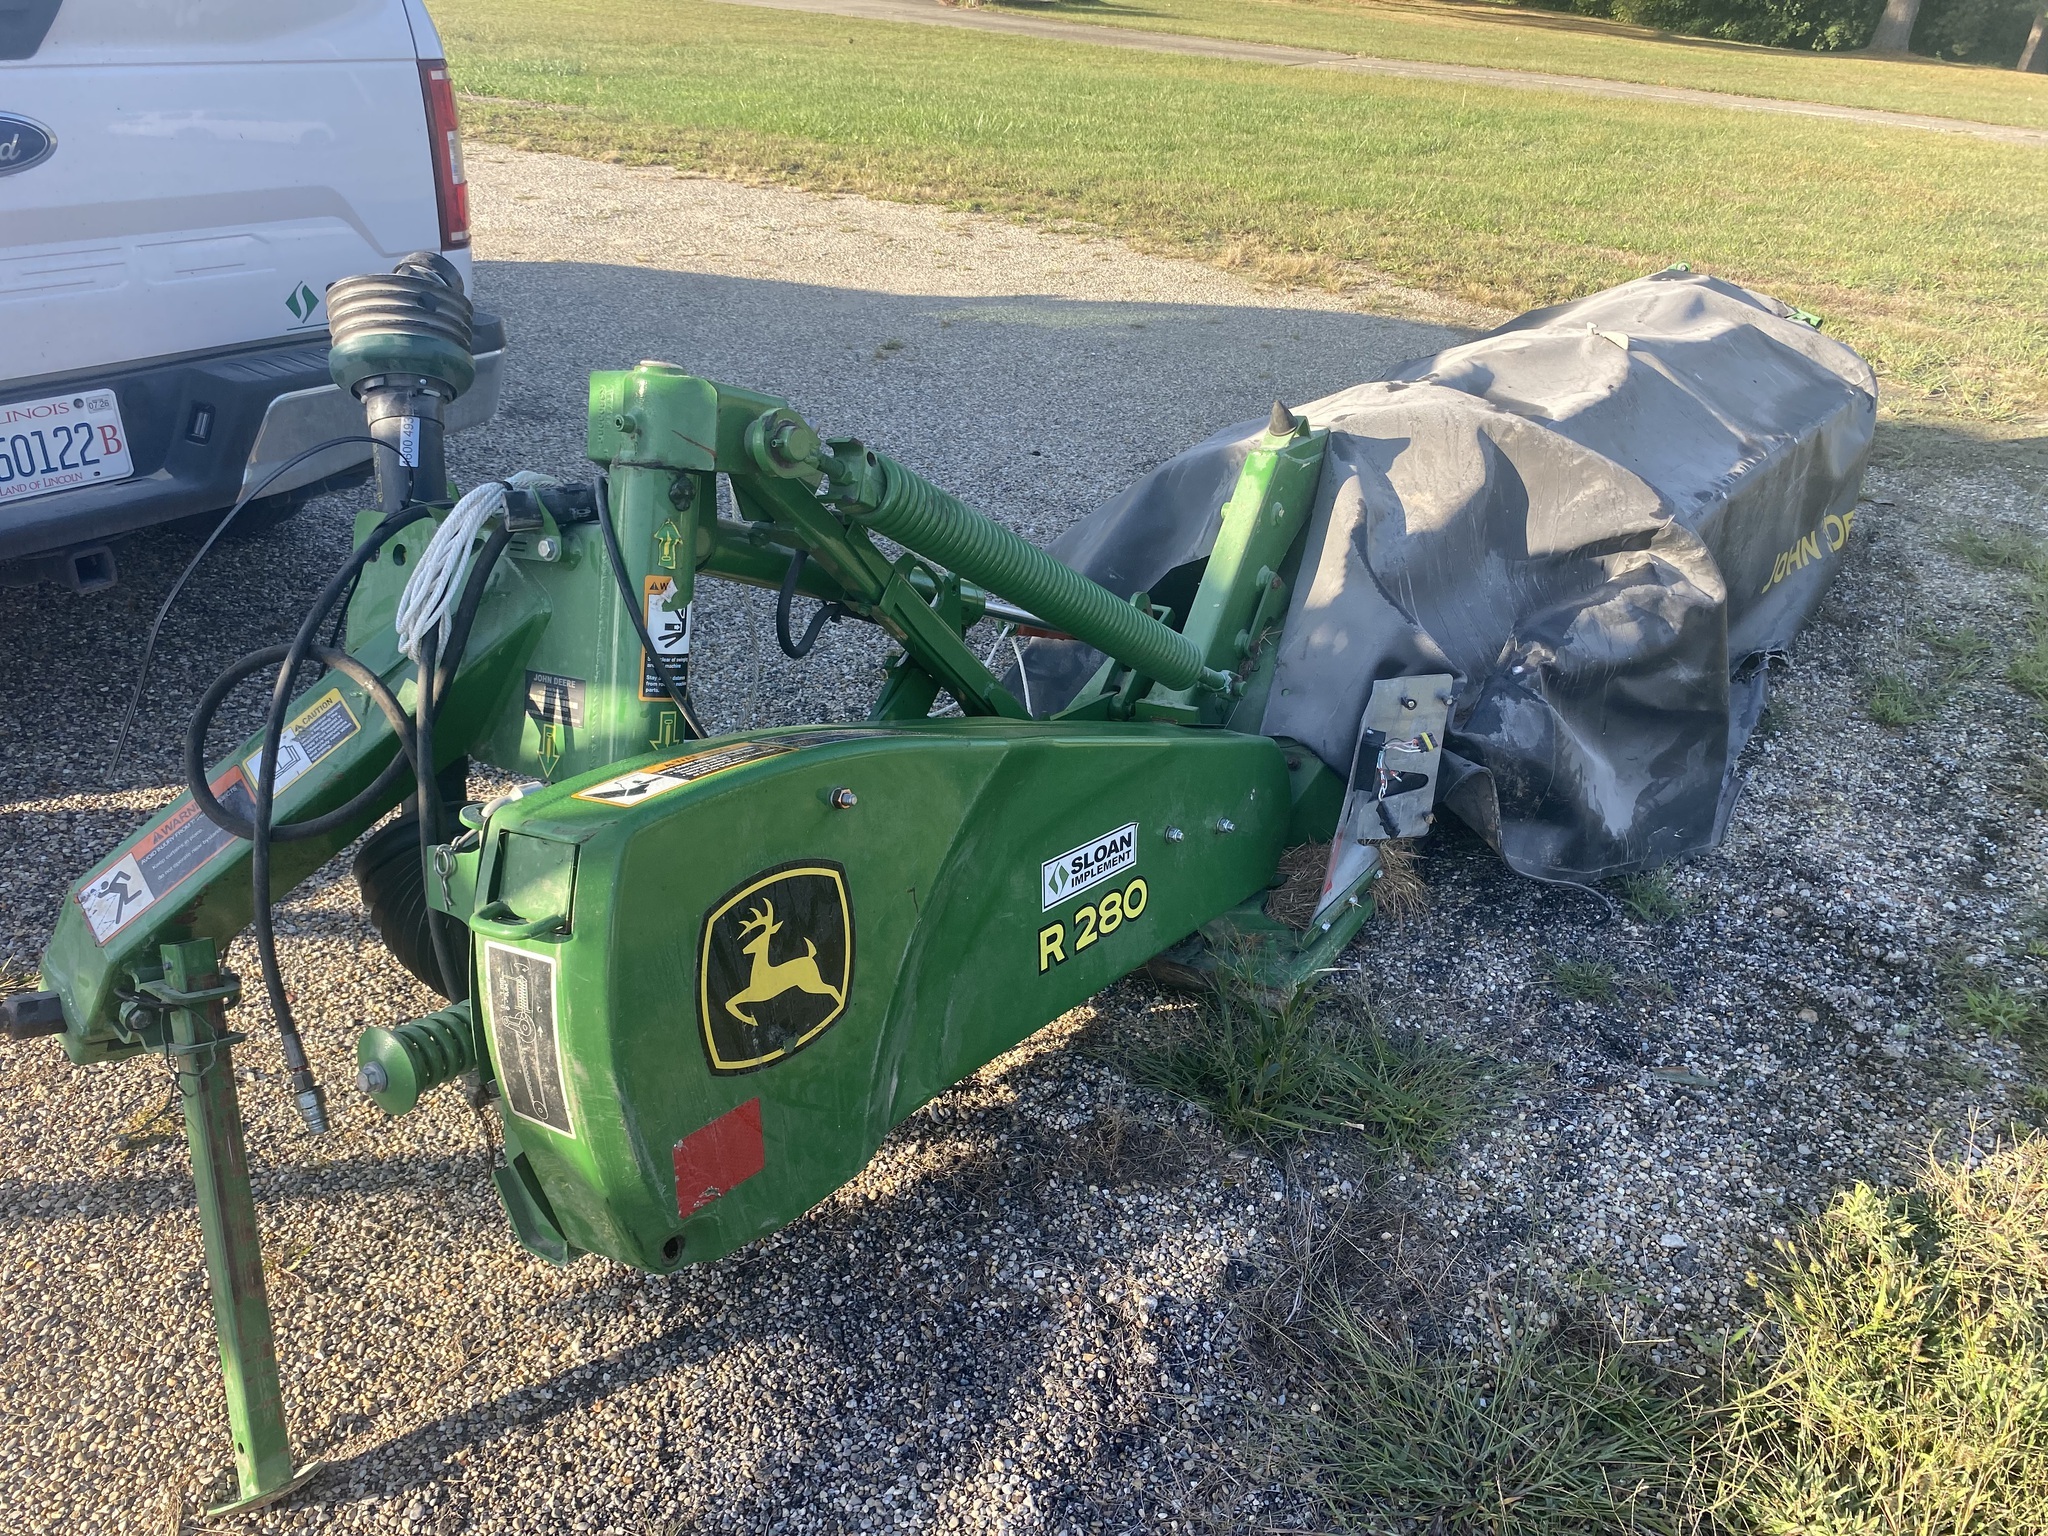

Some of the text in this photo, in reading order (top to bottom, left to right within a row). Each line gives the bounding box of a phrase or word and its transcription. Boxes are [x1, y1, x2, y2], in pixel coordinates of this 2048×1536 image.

[0, 402, 70, 424] INOIS
[97, 424, 122, 456] B
[29, 480, 41, 490] OF
[43, 472, 83, 488] LINCOLN
[1761, 530, 1823, 594] JOHN
[533, 673, 576, 689] JOHN DEERE
[302, 697, 334, 724] CAUTION
[161, 802, 201, 836] WARNI
[1070, 831, 1133, 888] SLOAN IMPLEMENT
[1038, 877, 1149, 975] R 280
